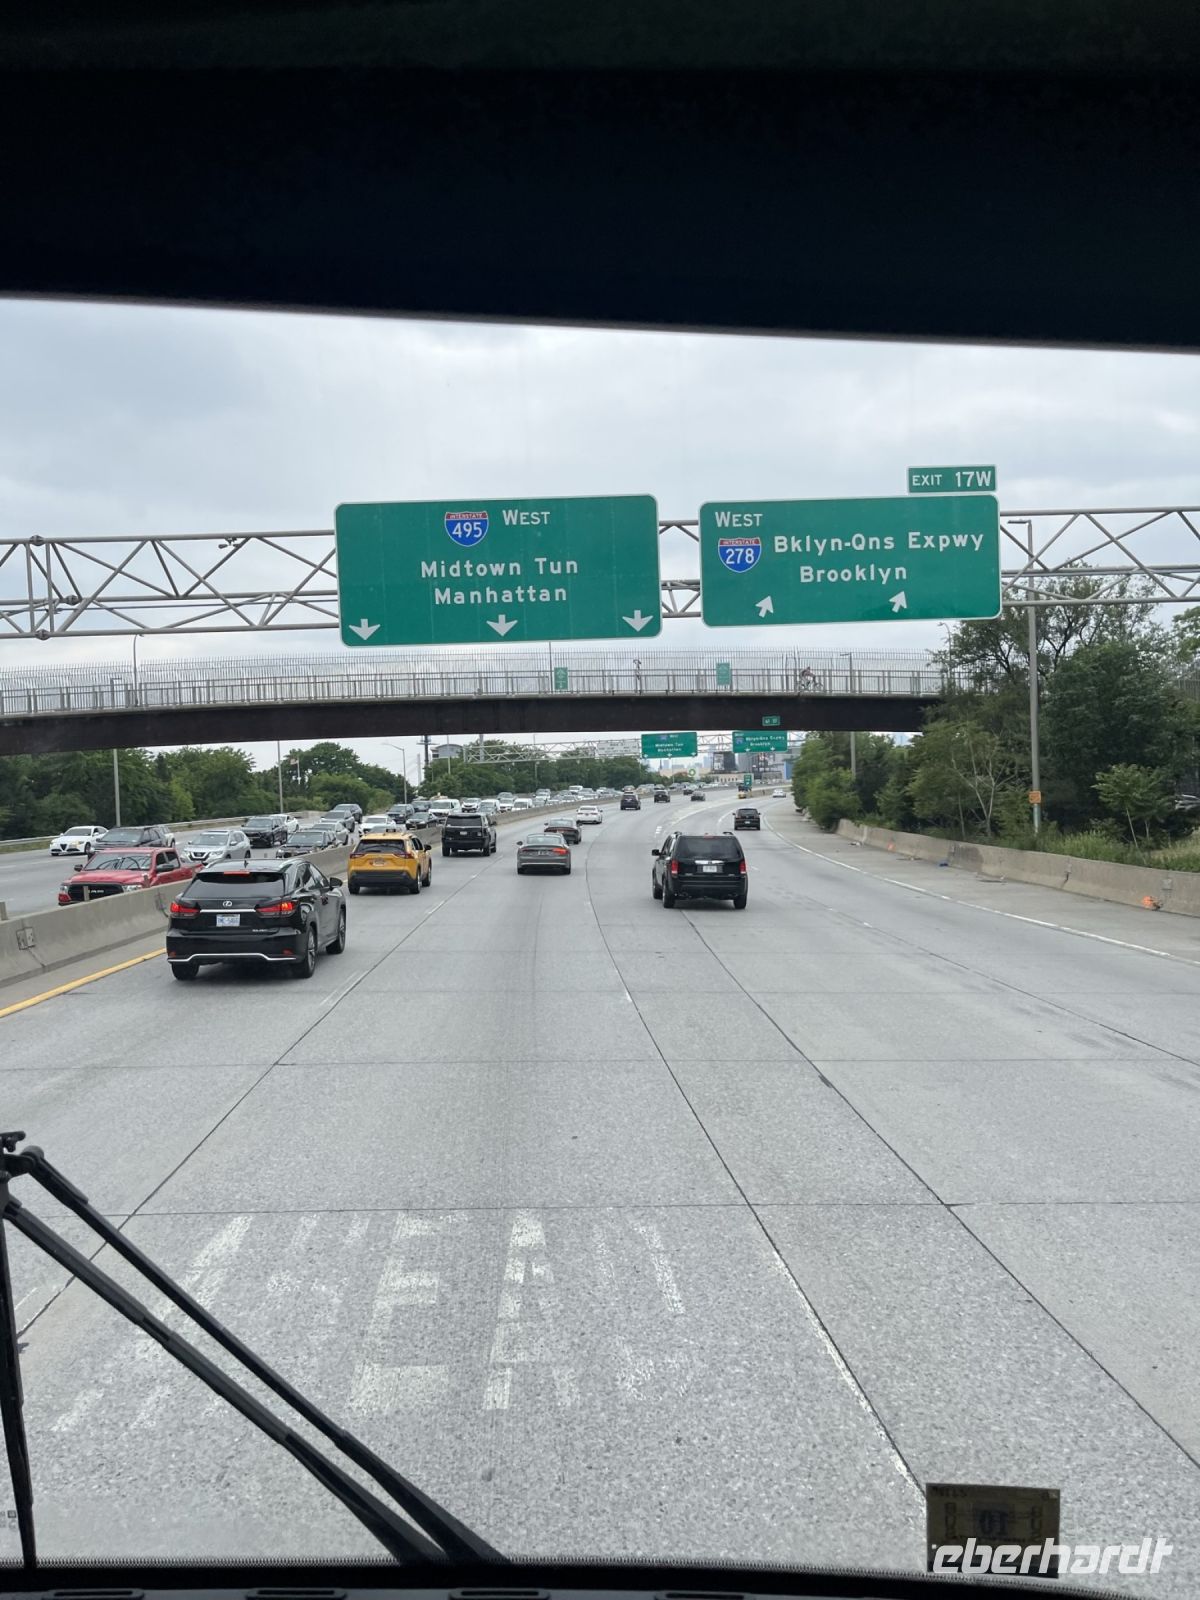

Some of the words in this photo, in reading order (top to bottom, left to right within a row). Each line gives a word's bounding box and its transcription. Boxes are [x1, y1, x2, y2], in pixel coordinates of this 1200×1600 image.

[911, 474, 942, 487] EXIT
[955, 471, 992, 487] 17W
[502, 509, 551, 526] WEST
[715, 511, 763, 528] WEST
[452, 521, 483, 540] 495
[774, 533, 895, 556] Bklyn-Qns
[908, 531, 984, 552] Expwy
[725, 547, 755, 565] 278
[421, 559, 521, 579] Midtown
[534, 557, 579, 575] Tun
[800, 564, 907, 585] Brooklyn
[434, 585, 567, 605] Manhattan
